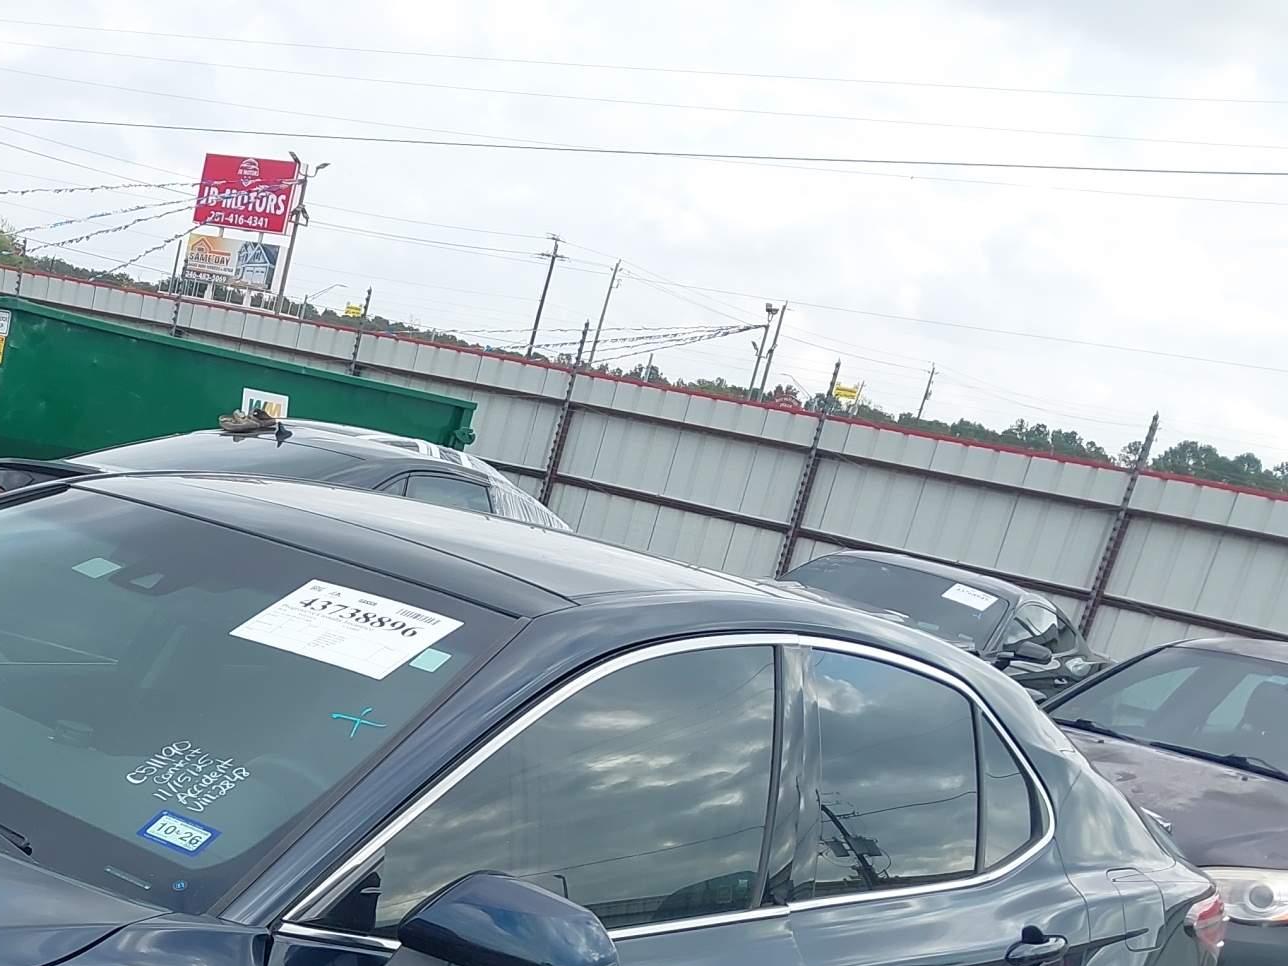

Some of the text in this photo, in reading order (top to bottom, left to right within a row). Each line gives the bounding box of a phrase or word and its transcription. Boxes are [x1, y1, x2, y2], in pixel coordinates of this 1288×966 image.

[200, 186, 286, 215] JB MOTORS
[189, 252, 231, 266] SAME DAY
[299, 598, 423, 638] 43738896
[176, 758, 233, 805] Accident
